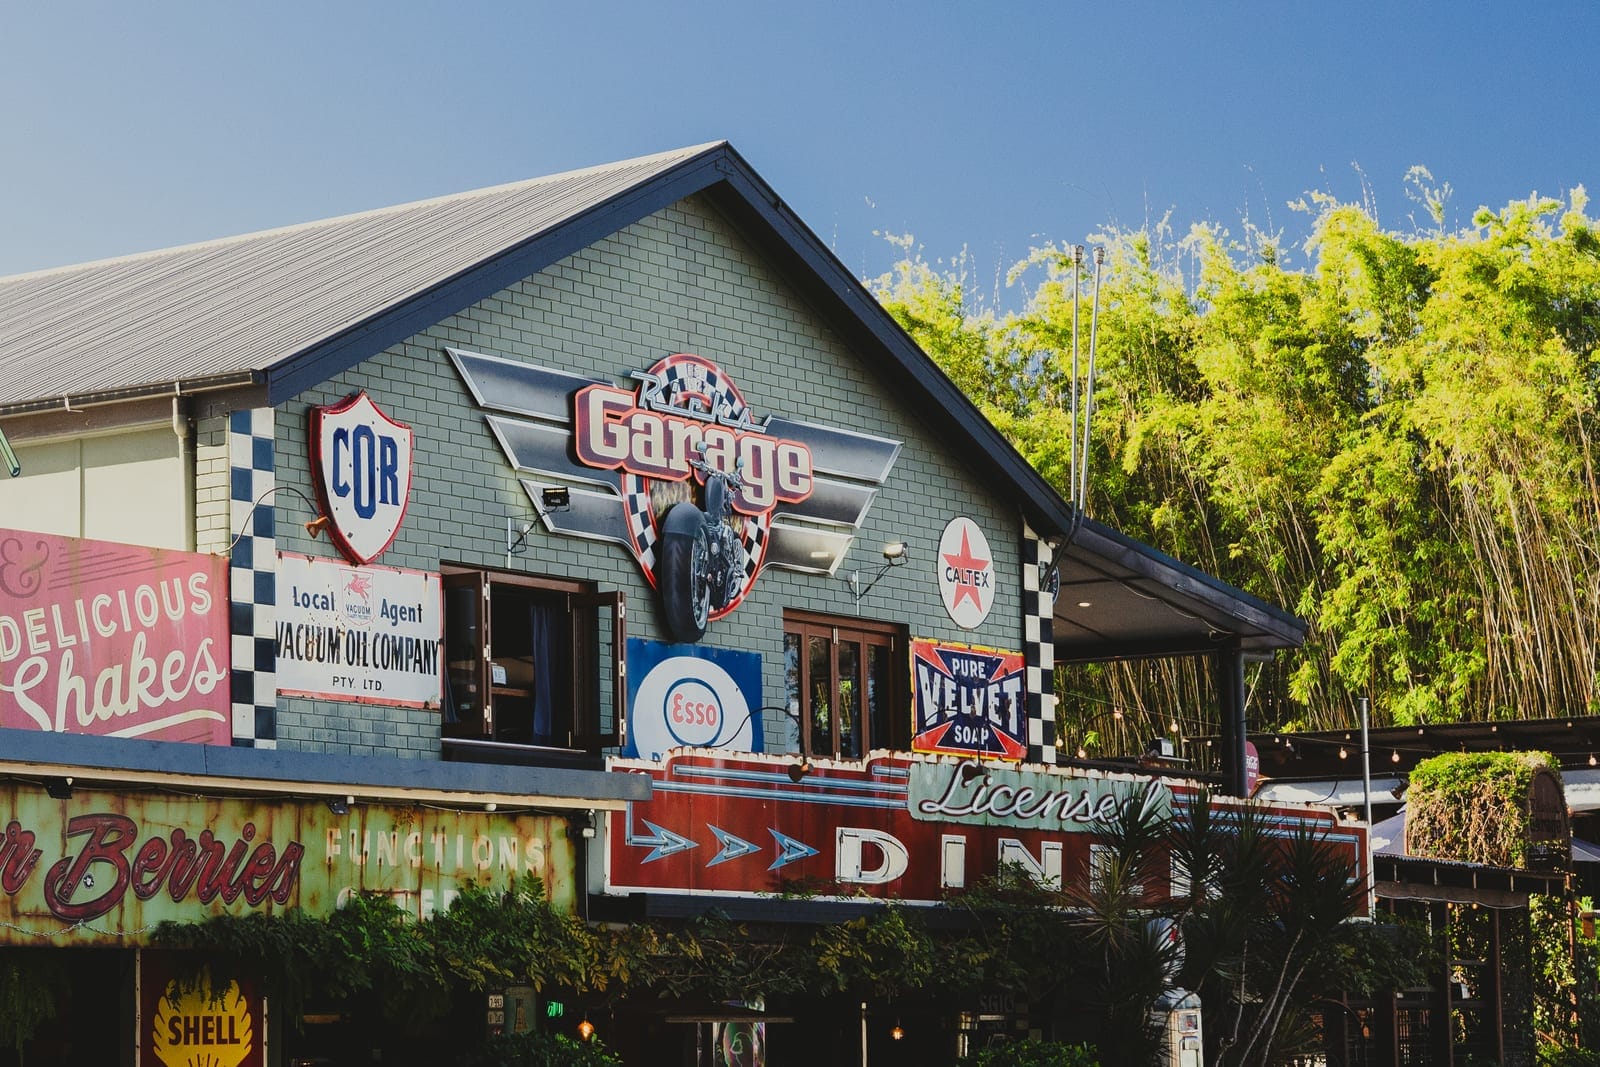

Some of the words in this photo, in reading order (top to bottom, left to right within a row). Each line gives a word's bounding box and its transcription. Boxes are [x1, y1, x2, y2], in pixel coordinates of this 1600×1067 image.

[332, 424, 400, 519] COR
[588, 387, 811, 504] Garage
[945, 566, 990, 588] CALTEX
[0, 572, 212, 663] DELICIOUS
[293, 586, 335, 612] Local
[380, 598, 422, 626] Agent
[345, 604, 371, 615] VACUUM
[275, 620, 340, 664] VACUUM
[345, 629, 369, 667] OIL
[372, 632, 439, 676] COMPANY
[952, 658, 986, 679] PURE
[0, 631, 226, 733] Shakes
[918, 663, 1020, 735] VELVET
[954, 725, 989, 745] SOAP
[0, 820, 43, 895] r
[44, 813, 304, 922] Berries
[326, 828, 546, 871] FUNCTIONS
[168, 1015, 241, 1046] SHELL
